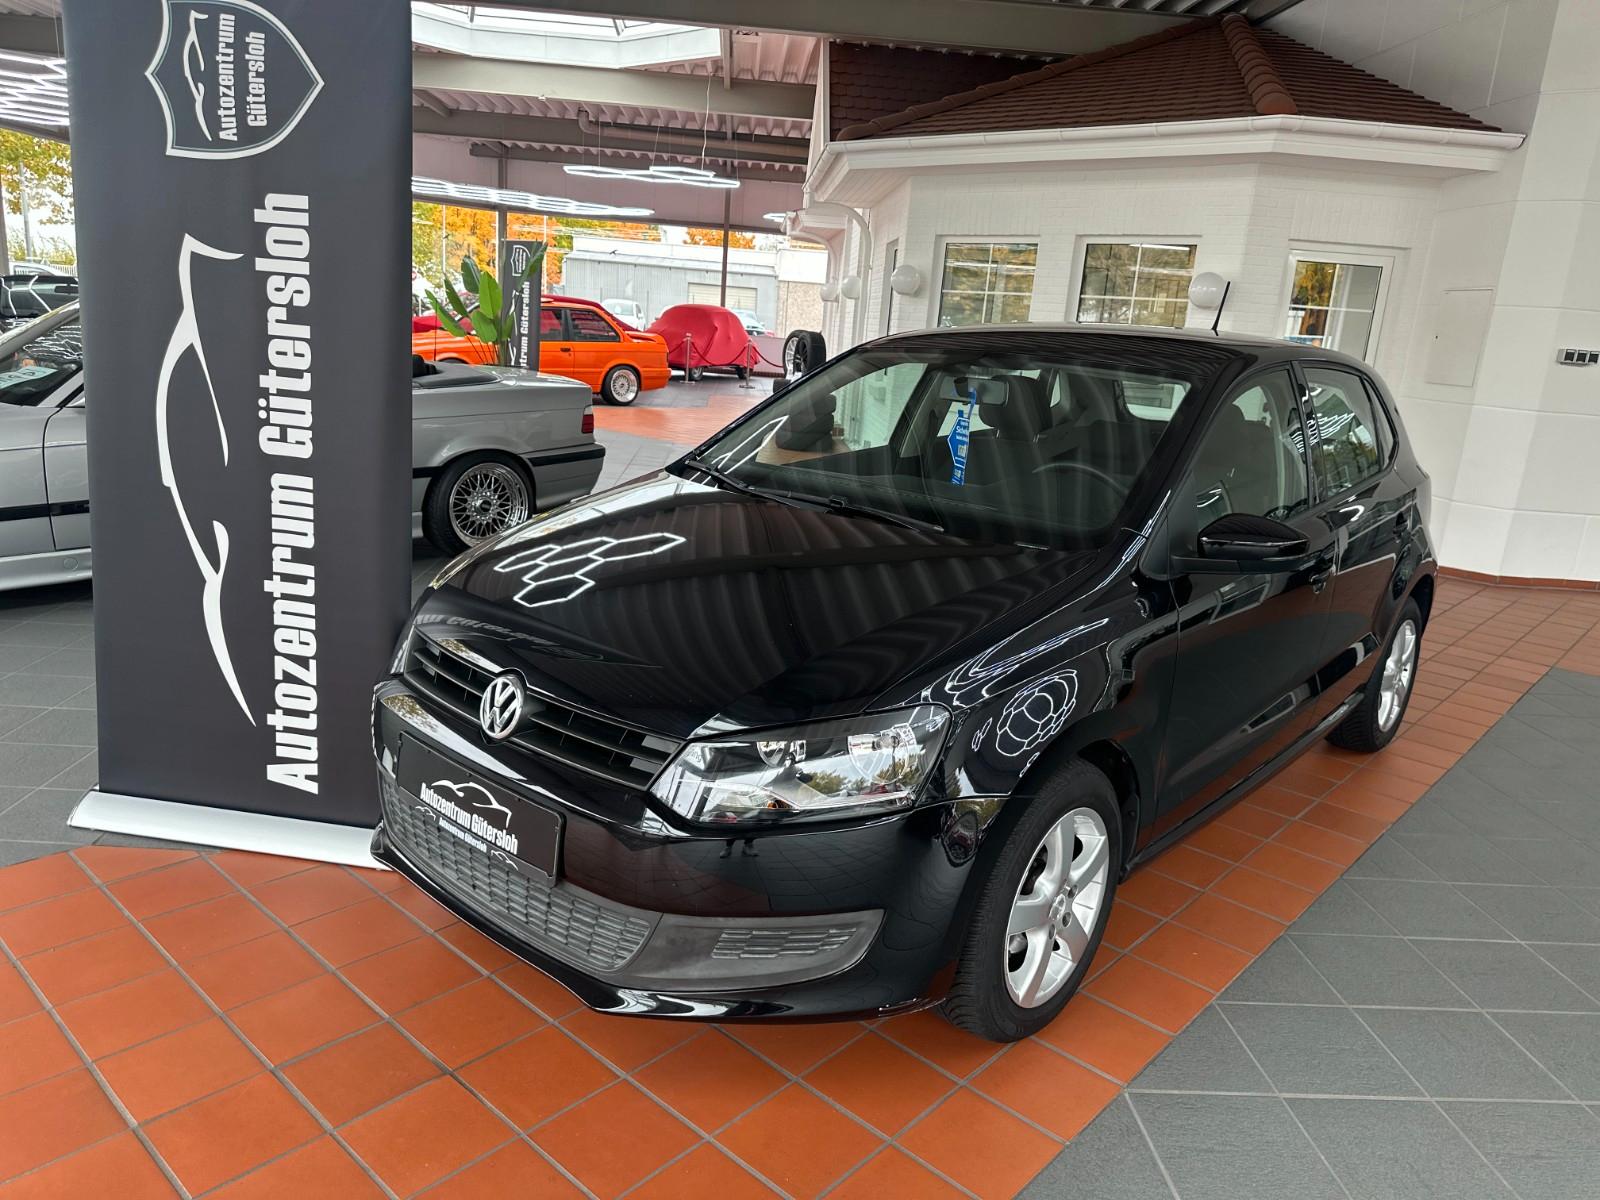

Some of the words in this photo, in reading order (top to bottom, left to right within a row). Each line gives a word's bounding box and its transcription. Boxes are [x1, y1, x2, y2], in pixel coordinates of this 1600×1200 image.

[216, 13, 238, 141] Autozentrum
[245, 31, 268, 127] Gütersloh
[254, 193, 313, 459] Gütersloh
[520, 282, 531, 335] Gütersloh
[263, 472, 319, 795] Autozentrum
[420, 782, 472, 829] Autozentrum
[471, 813, 519, 855] Gütersloh
